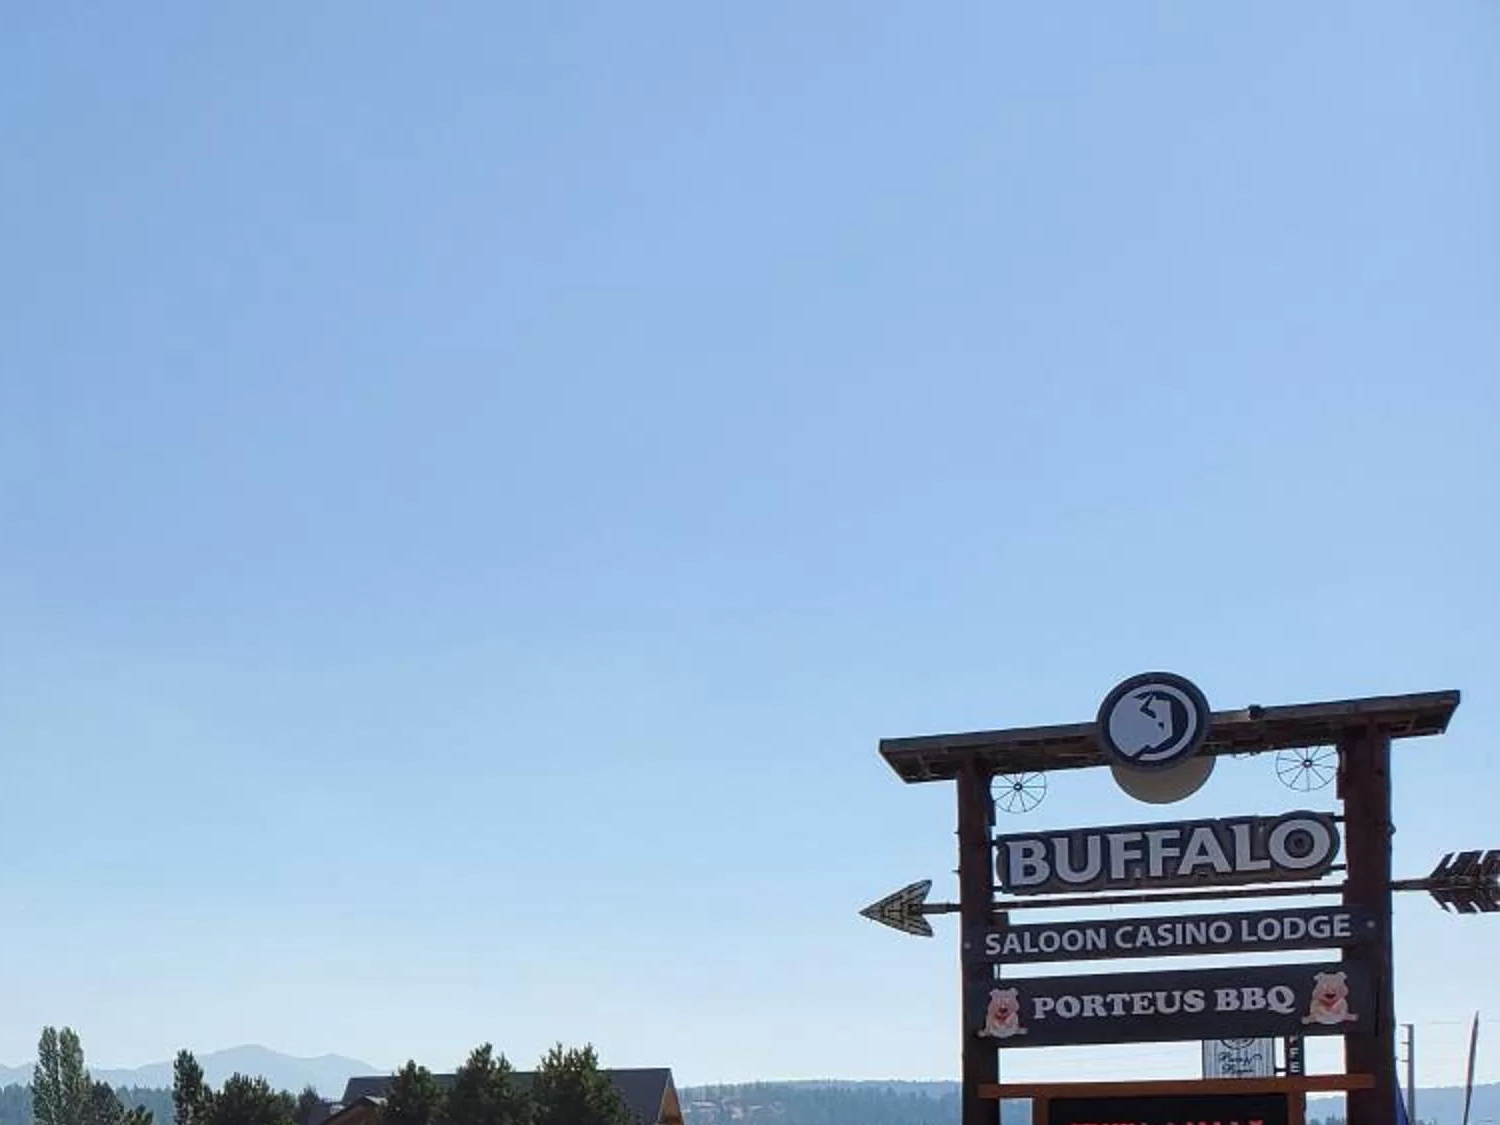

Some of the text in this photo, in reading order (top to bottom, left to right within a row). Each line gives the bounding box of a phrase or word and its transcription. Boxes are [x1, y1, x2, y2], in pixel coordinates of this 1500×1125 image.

[1005, 819, 1331, 886] BUFFALO
[985, 914, 1352, 956] SALOON CASINO LODGE
[1032, 985, 1296, 1019] PORTEUS BBQ
